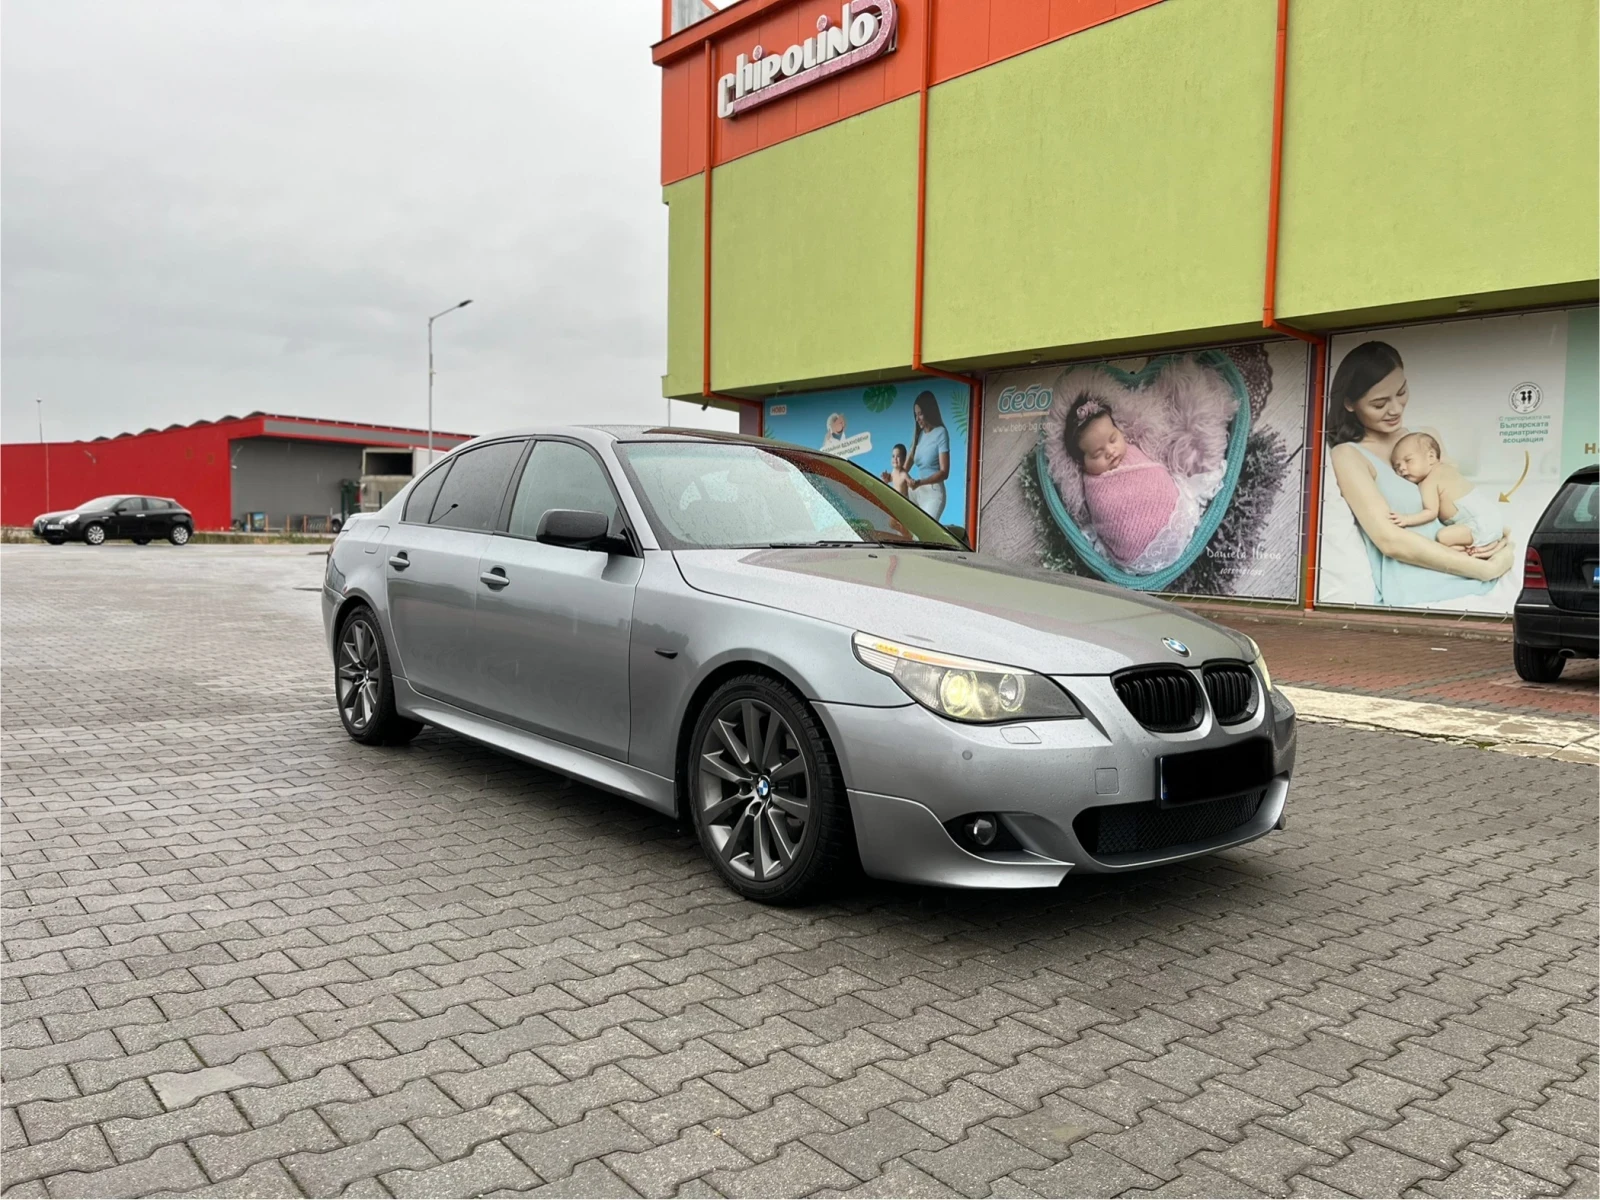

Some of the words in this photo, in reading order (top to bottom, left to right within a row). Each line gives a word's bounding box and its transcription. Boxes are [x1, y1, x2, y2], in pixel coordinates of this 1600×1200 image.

[998, 383, 1051, 413] бебо
[1499, 421, 1549, 430] Българската
[1499, 429, 1549, 437] педиатрична
[1502, 436, 1544, 444] асоциация
[1205, 543, 1247, 560] Daniela
